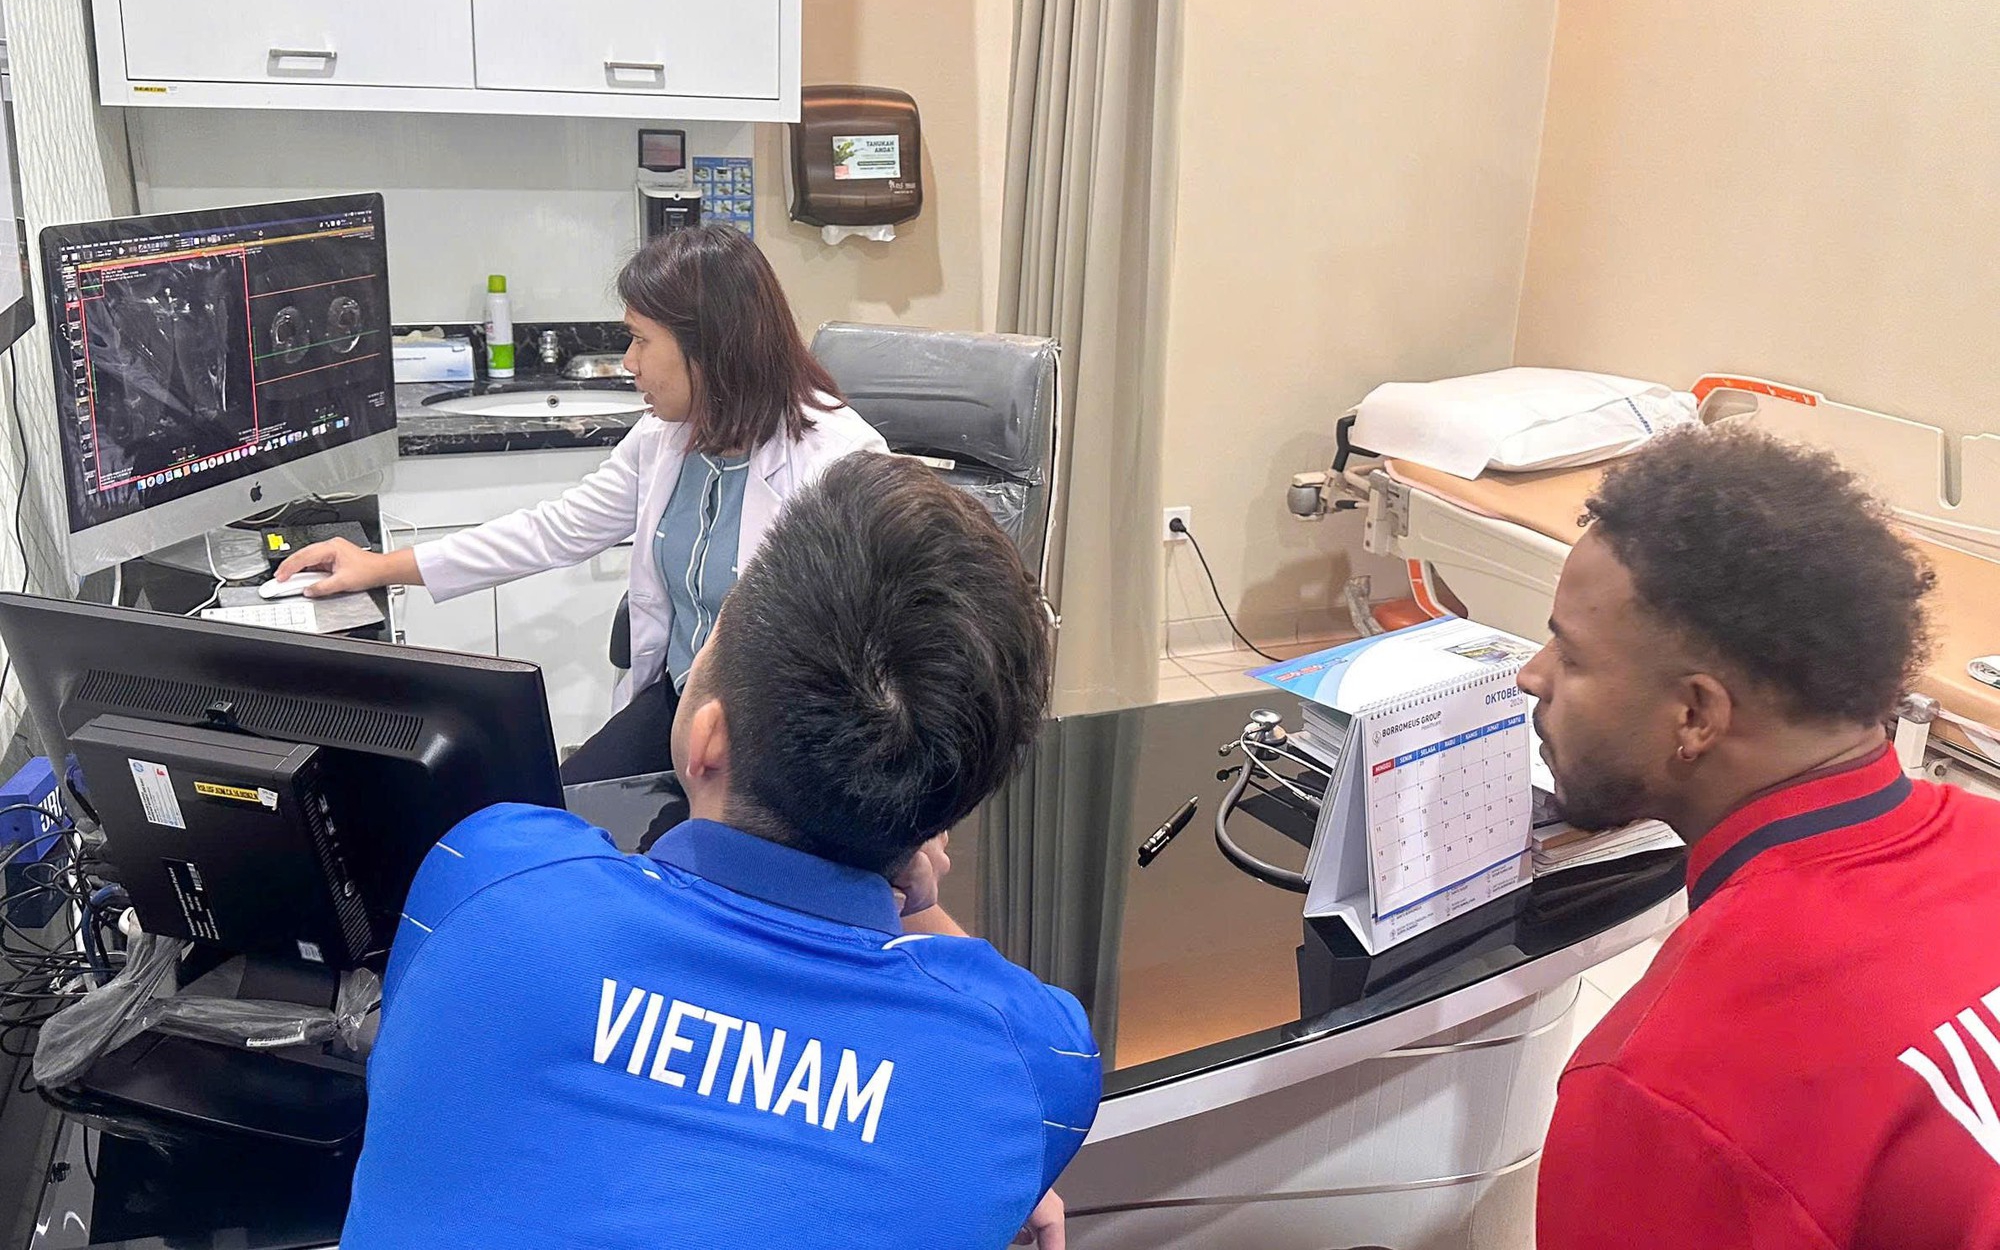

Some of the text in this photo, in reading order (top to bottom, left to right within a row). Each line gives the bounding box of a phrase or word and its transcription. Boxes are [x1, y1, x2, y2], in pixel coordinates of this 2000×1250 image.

[1375, 762, 1392, 773] MINGGU
[1399, 754, 1412, 764] SENIN
[1420, 745, 1436, 756] SELASA
[1507, 717, 1521, 725] SABTU
[1382, 710, 1442, 738] BORROMEUS GROUP
[593, 977, 895, 1143] VIETNAM
